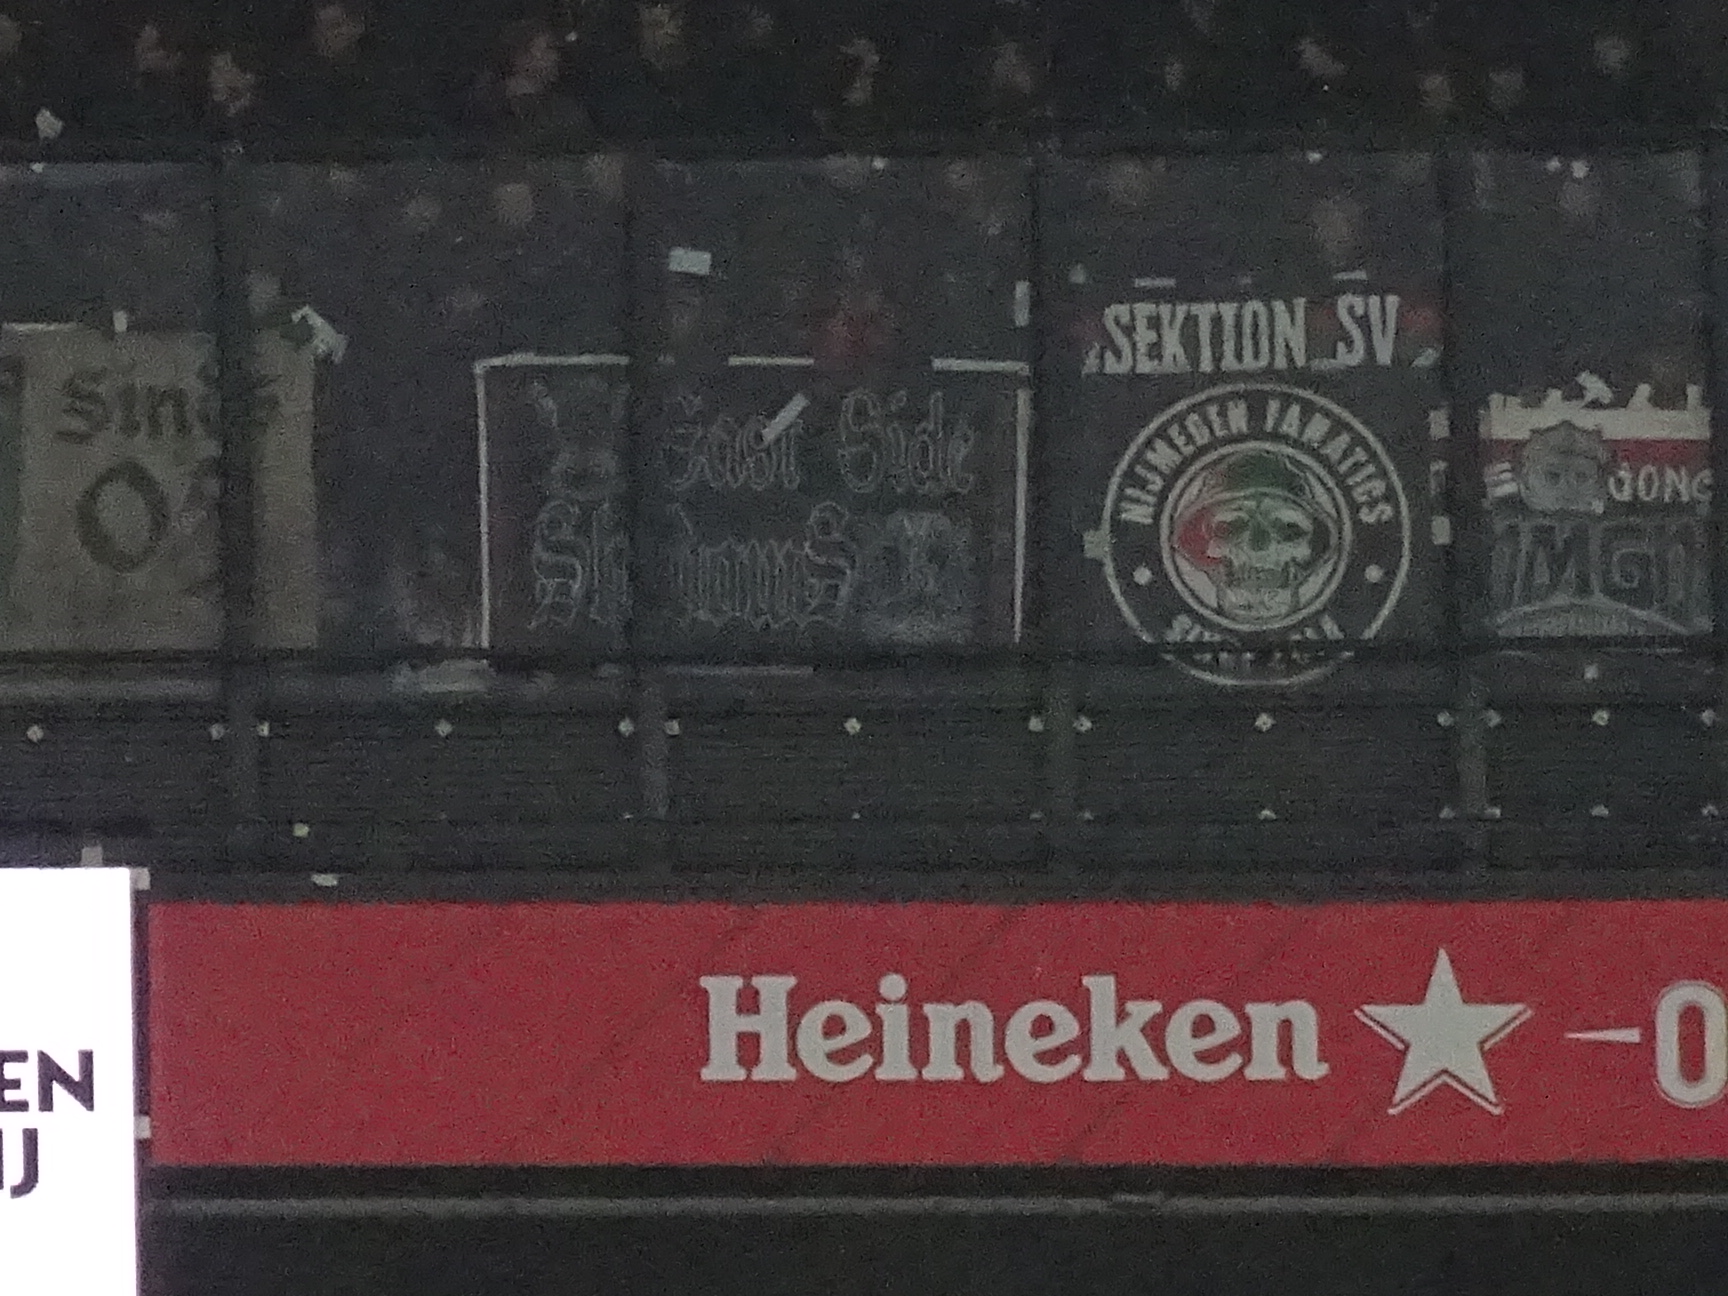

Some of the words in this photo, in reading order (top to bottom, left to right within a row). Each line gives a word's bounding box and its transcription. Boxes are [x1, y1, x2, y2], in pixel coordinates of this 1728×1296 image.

[1102, 296, 1306, 373] SEKTION
[1336, 293, 1400, 368] SV
[700, 973, 1330, 1082] Heineken
